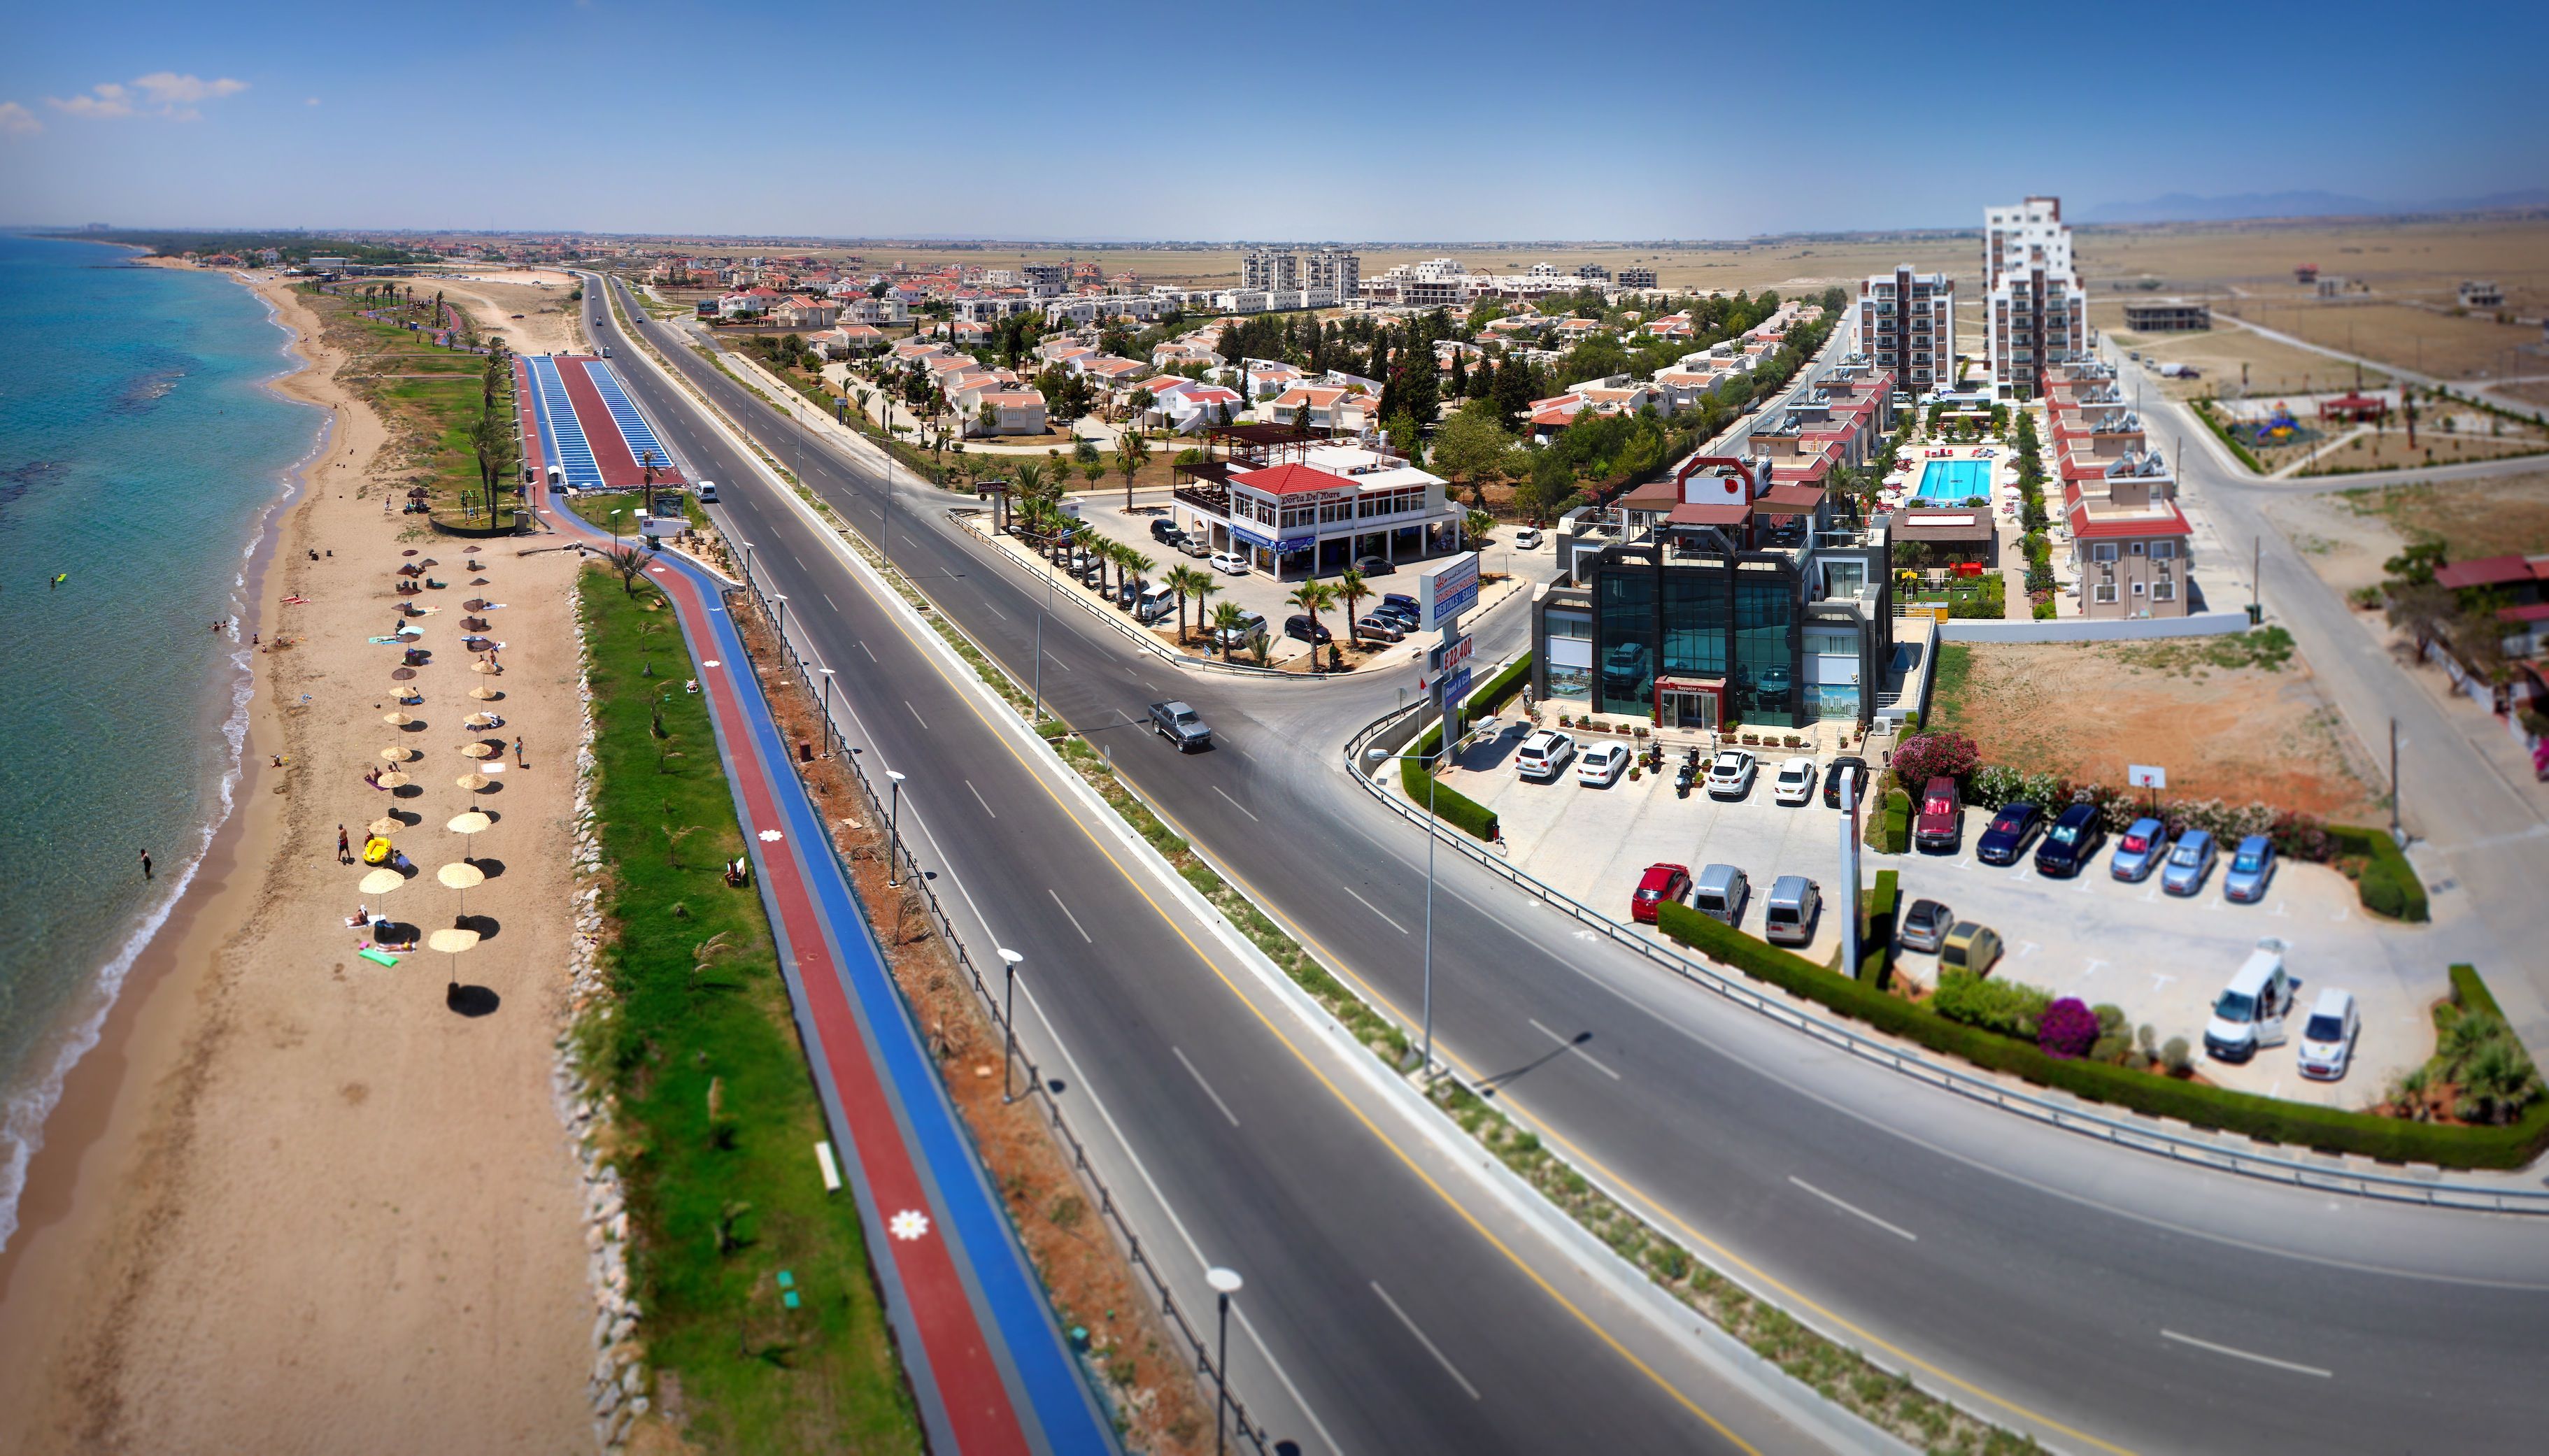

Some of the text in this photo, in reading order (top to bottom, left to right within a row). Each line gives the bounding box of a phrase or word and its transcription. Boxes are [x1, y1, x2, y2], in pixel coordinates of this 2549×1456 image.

[1281, 492, 1340, 505] Porta Del Mare
[1435, 585, 1458, 603] TOURISTIC
[1459, 574, 1476, 590] HOUSES
[1435, 594, 1458, 618] RENTALS
[1462, 584, 1477, 600] SALES
[1446, 681, 1457, 697] Rent
[1462, 674, 1470, 685] Car
